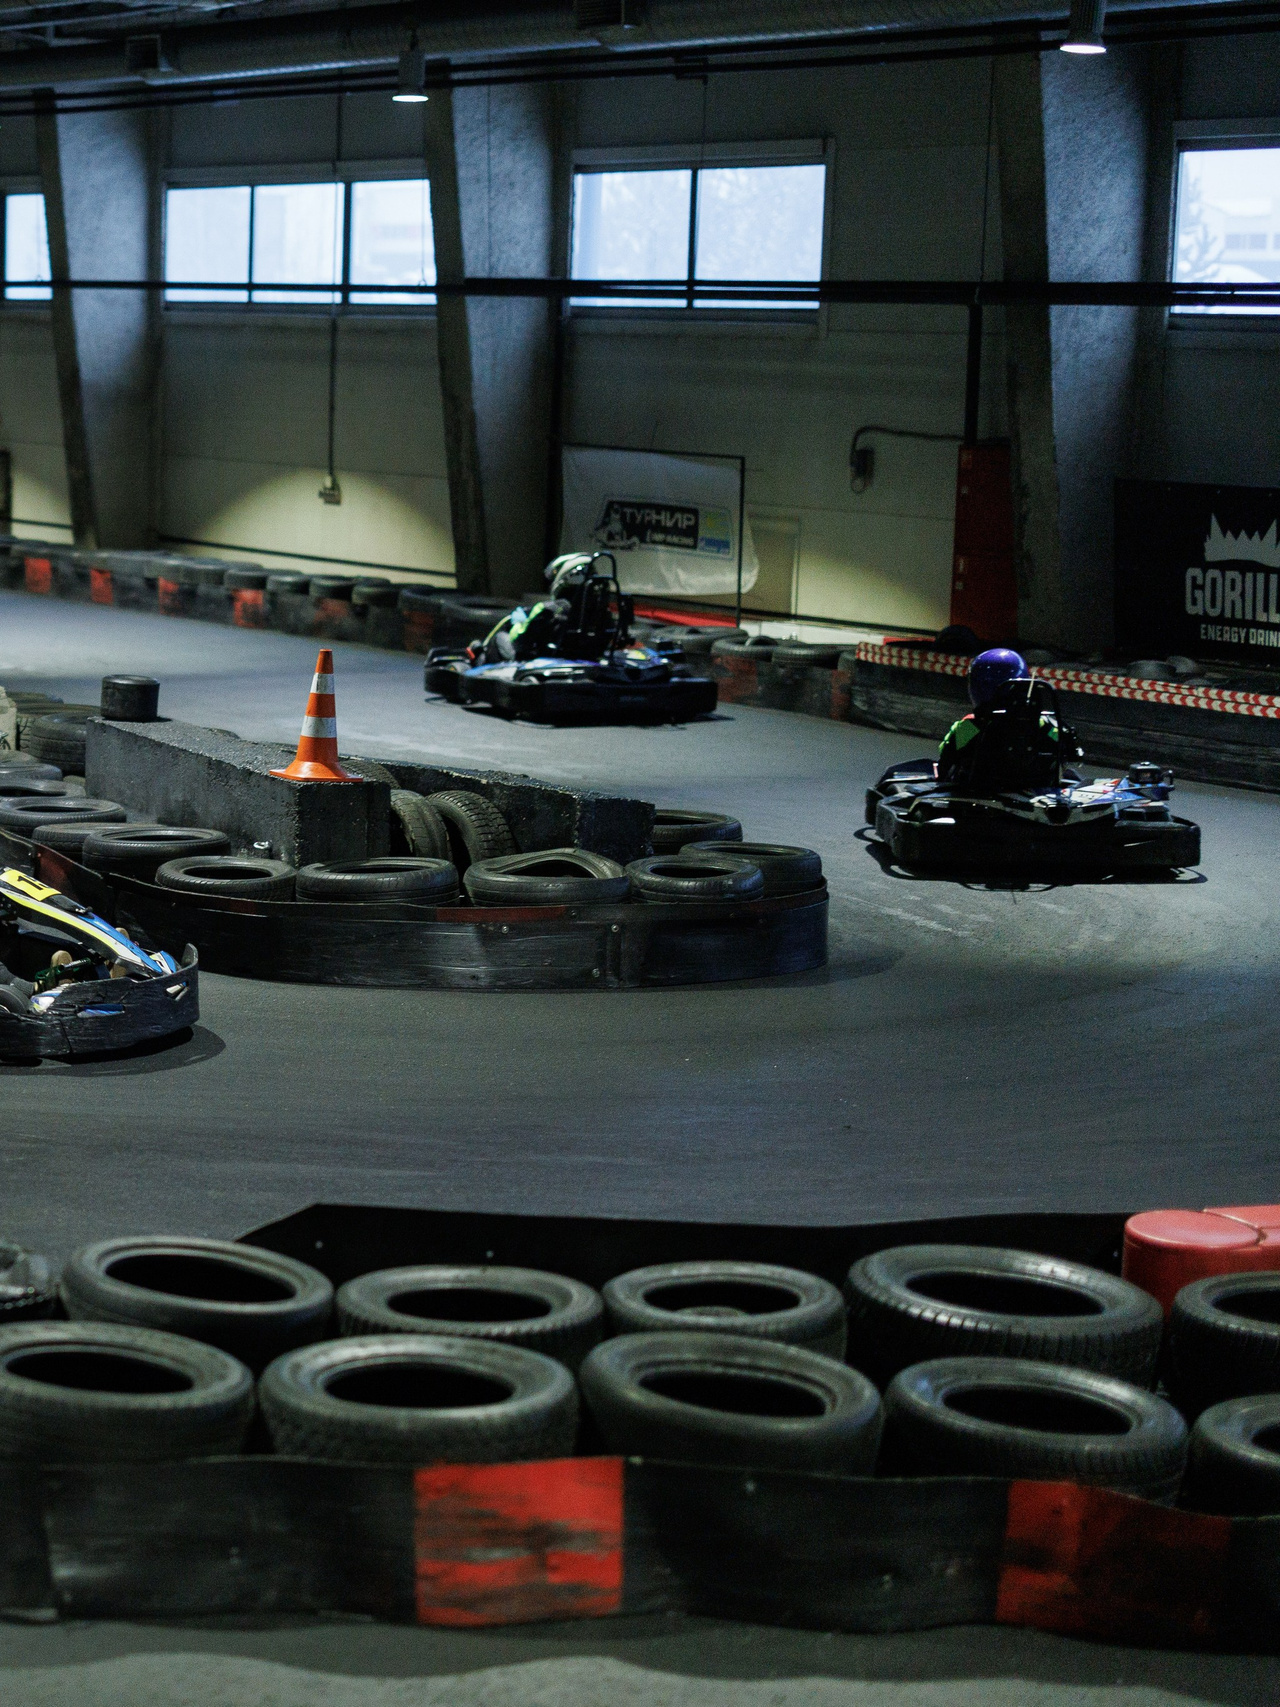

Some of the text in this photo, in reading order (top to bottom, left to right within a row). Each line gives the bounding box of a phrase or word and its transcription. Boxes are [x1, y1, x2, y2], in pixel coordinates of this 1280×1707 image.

[622, 507, 696, 530] ТУРНИР
[1185, 567, 1280, 624] GORILL
[1199, 623, 1247, 644] ENERGY
[17, 875, 48, 891] 1
